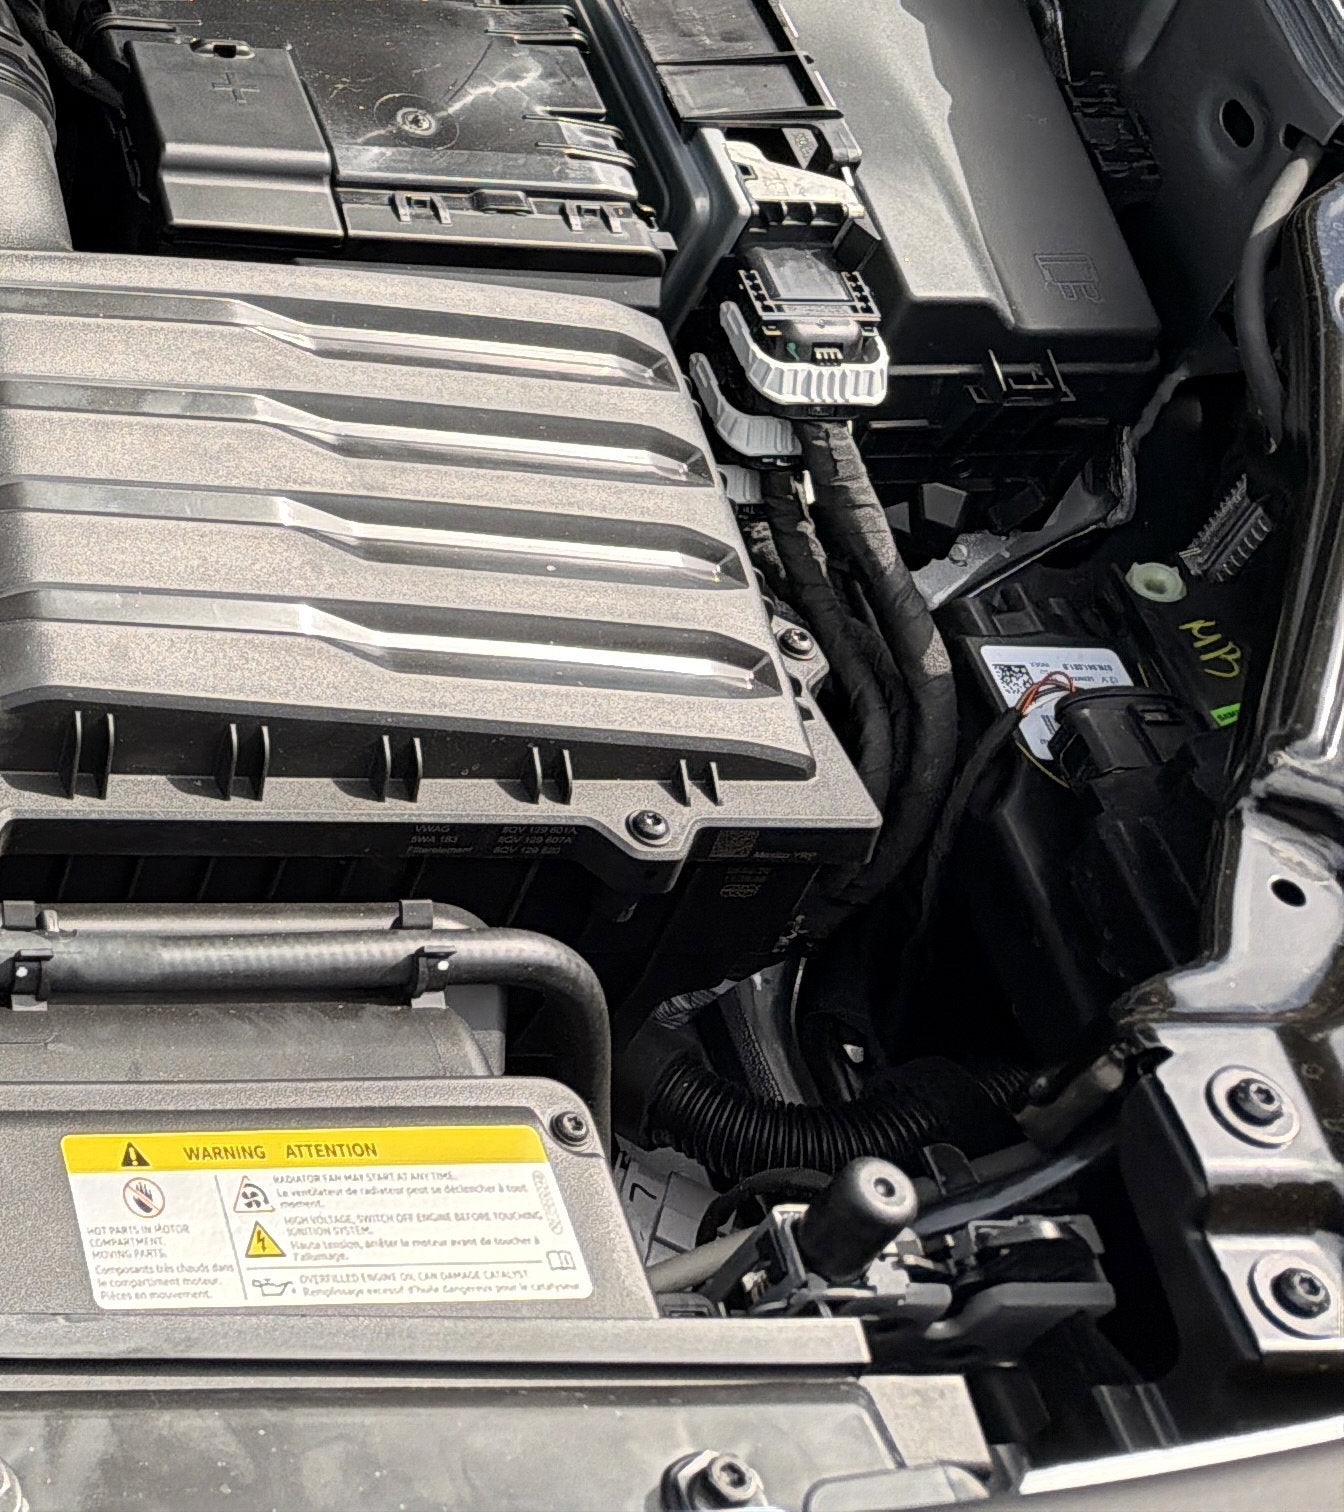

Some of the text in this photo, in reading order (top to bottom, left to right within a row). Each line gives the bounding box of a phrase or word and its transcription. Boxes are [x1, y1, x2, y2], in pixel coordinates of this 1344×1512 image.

[183, 1143, 378, 1161] WARNING ATTENTION
[273, 1175, 320, 1183] RADIATOR
[366, 1173, 394, 1181] START
[87, 1226, 106, 1235] HOT
[109, 1226, 139, 1235] PARTS
[154, 1224, 190, 1234] MOTOR
[95, 1264, 154, 1276] Composants
[176, 1263, 209, 1273] chauds
[212, 1263, 234, 1272] dans
[109, 1277, 180, 1288] compartiment
